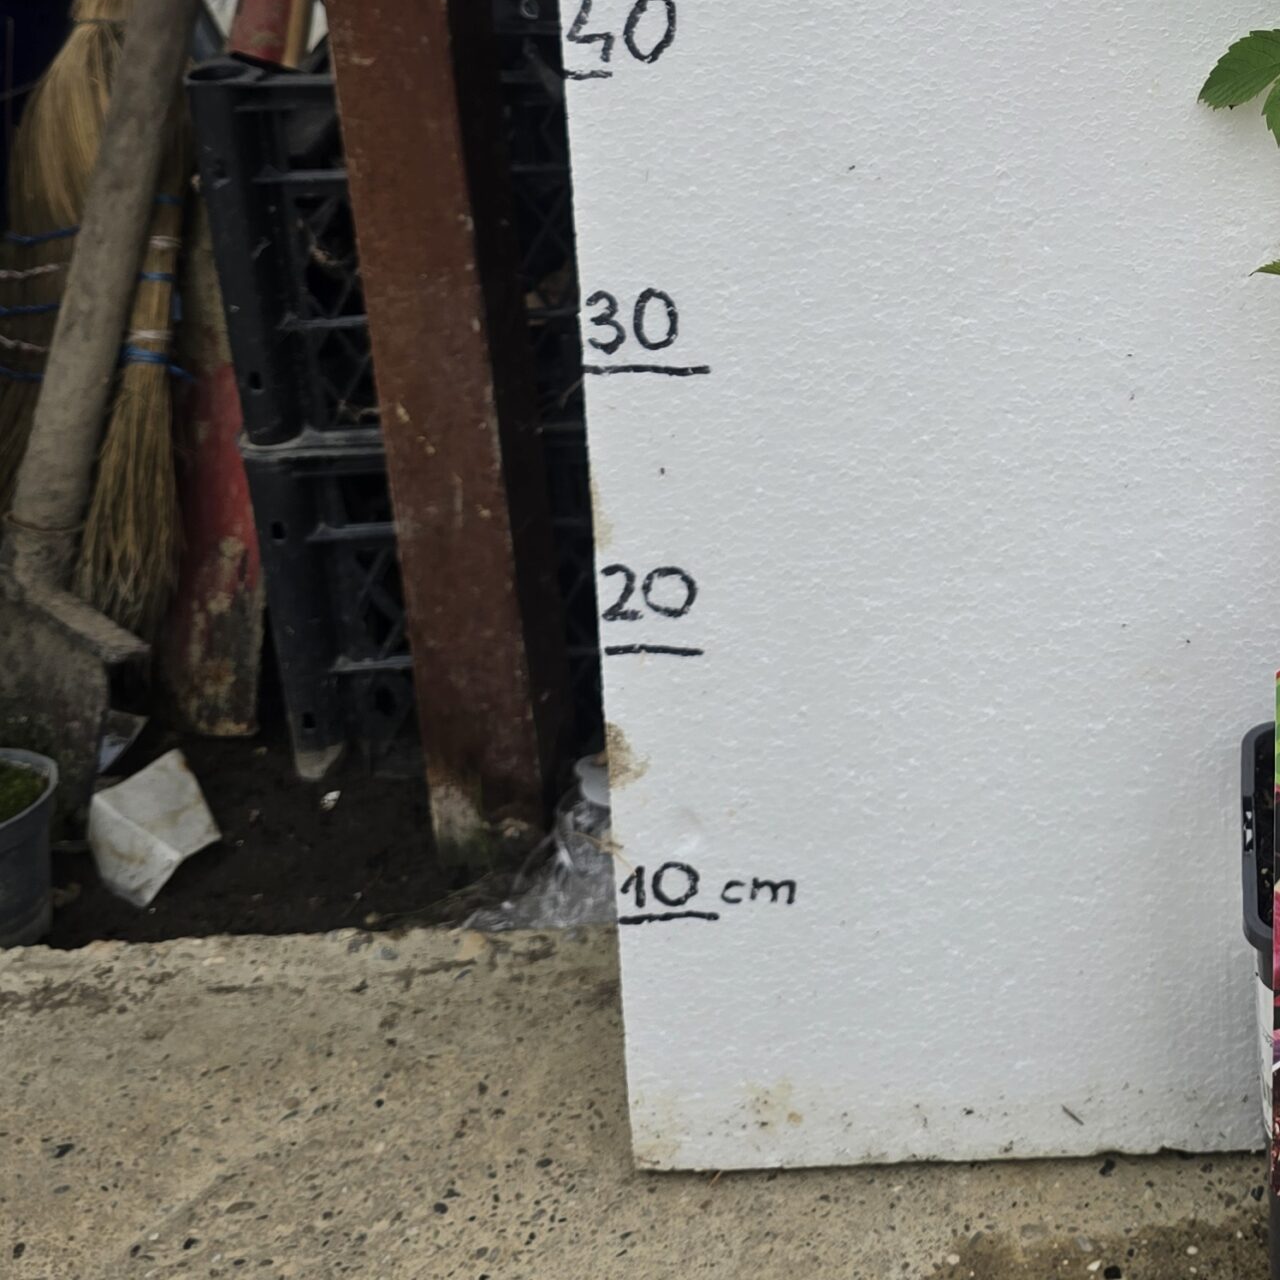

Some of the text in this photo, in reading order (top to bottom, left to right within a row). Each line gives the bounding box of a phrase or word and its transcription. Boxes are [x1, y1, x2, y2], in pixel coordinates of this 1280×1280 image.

[585, 287, 680, 355] 30
[601, 564, 699, 621] 20
[620, 861, 798, 909] 10 cm
